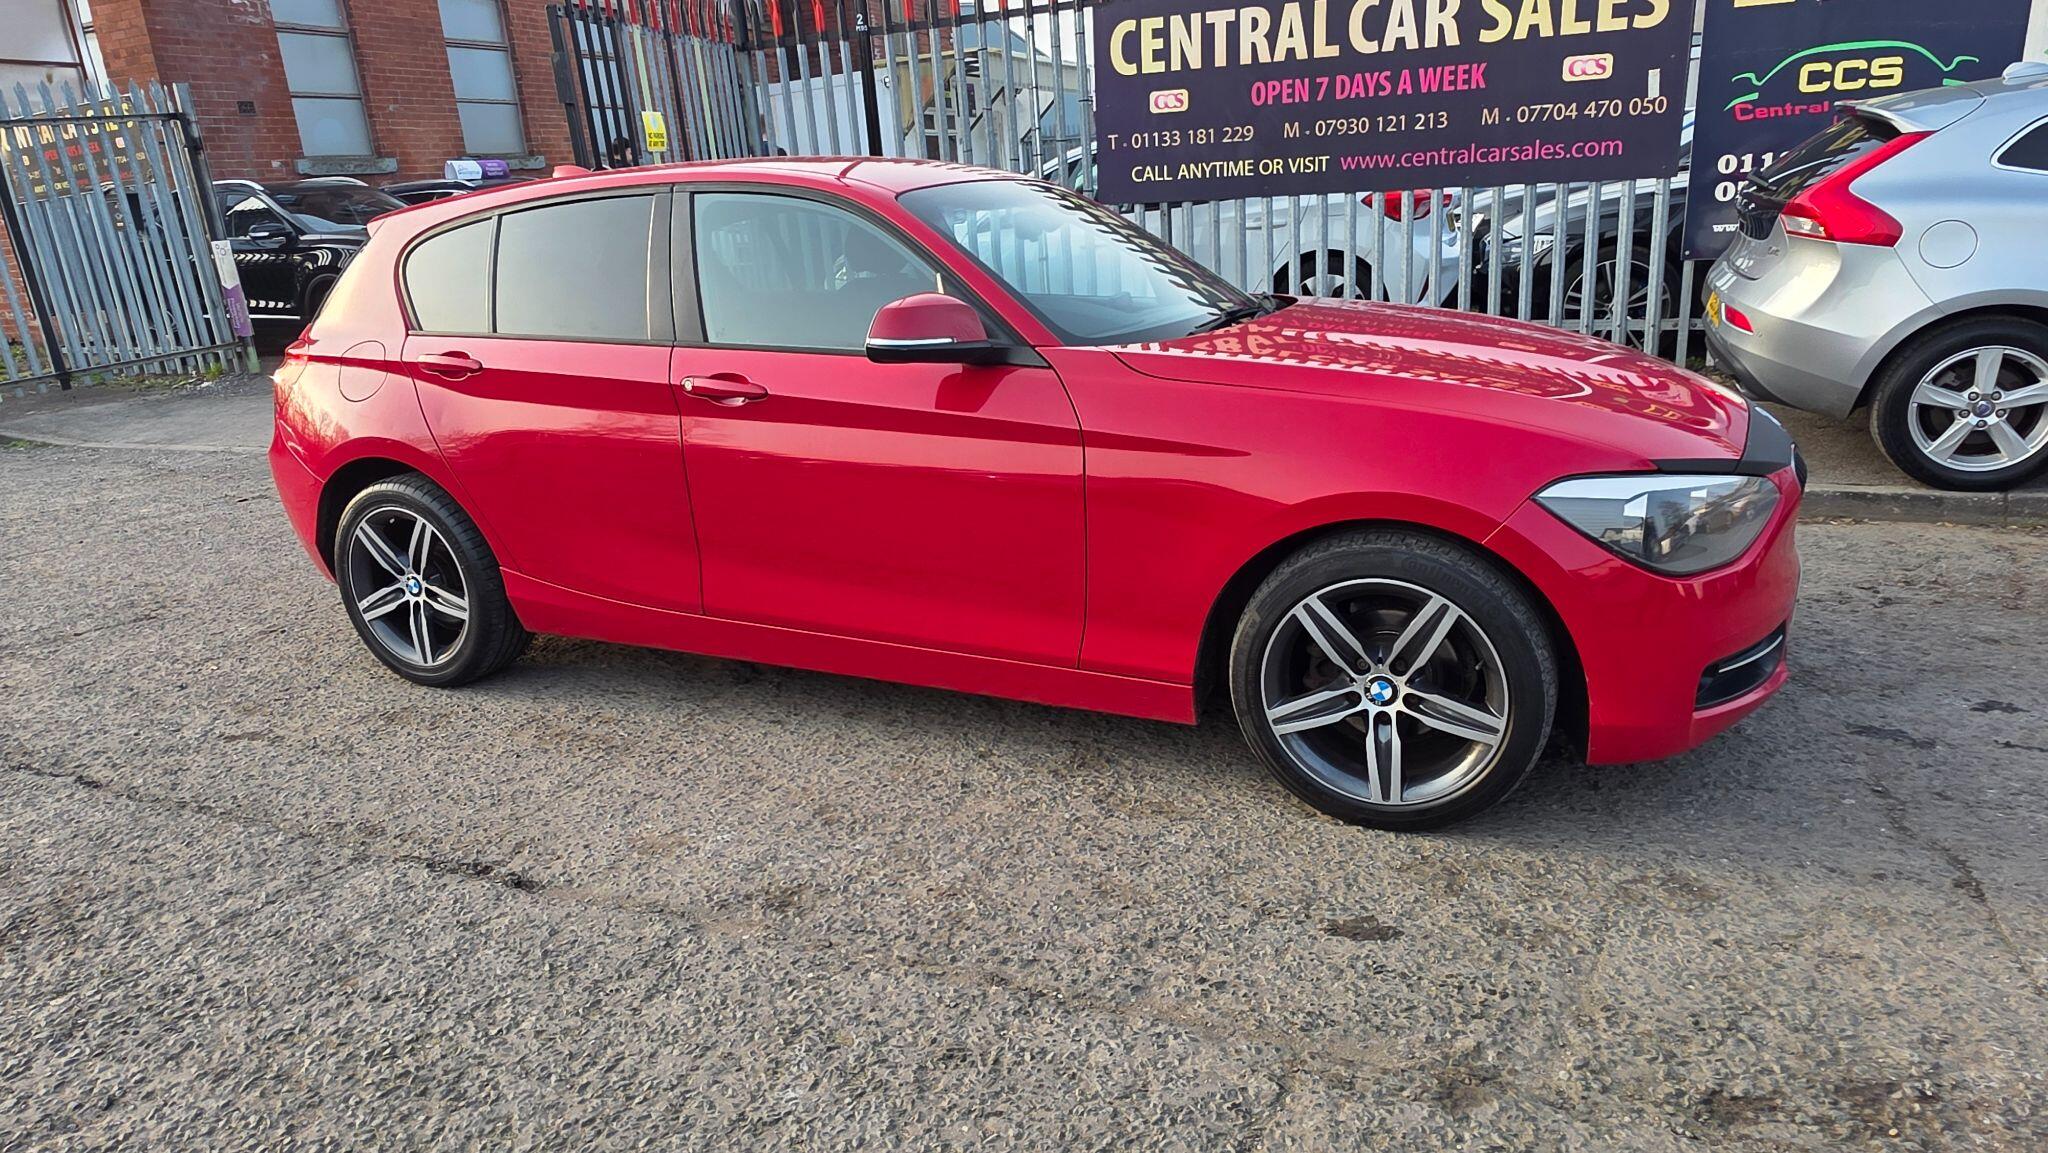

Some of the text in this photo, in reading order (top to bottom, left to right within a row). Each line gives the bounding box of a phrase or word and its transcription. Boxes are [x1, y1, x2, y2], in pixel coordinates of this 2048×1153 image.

[1110, 0, 1340, 76] CENTRAL
[1349, 0, 1460, 54] CAR
[1251, 62, 1488, 106] OPEN 7 DAYS A WEEK
[1799, 56, 1904, 93] CCS
[1131, 130, 1181, 149] 01133
[1187, 128, 1215, 145] 181
[1222, 125, 1254, 143] 229
[1315, 117, 1370, 137] 07930
[1376, 114, 1406, 133] 121
[1414, 111, 1448, 130] 213
[1517, 102, 1578, 123] 07704
[1583, 99, 1622, 118] 470
[1628, 96, 1667, 116] 050
[1734, 100, 1830, 121] Central
[1131, 139, 1623, 182] CALL ANYTIME OR VISIT www.centralcarsales.com
